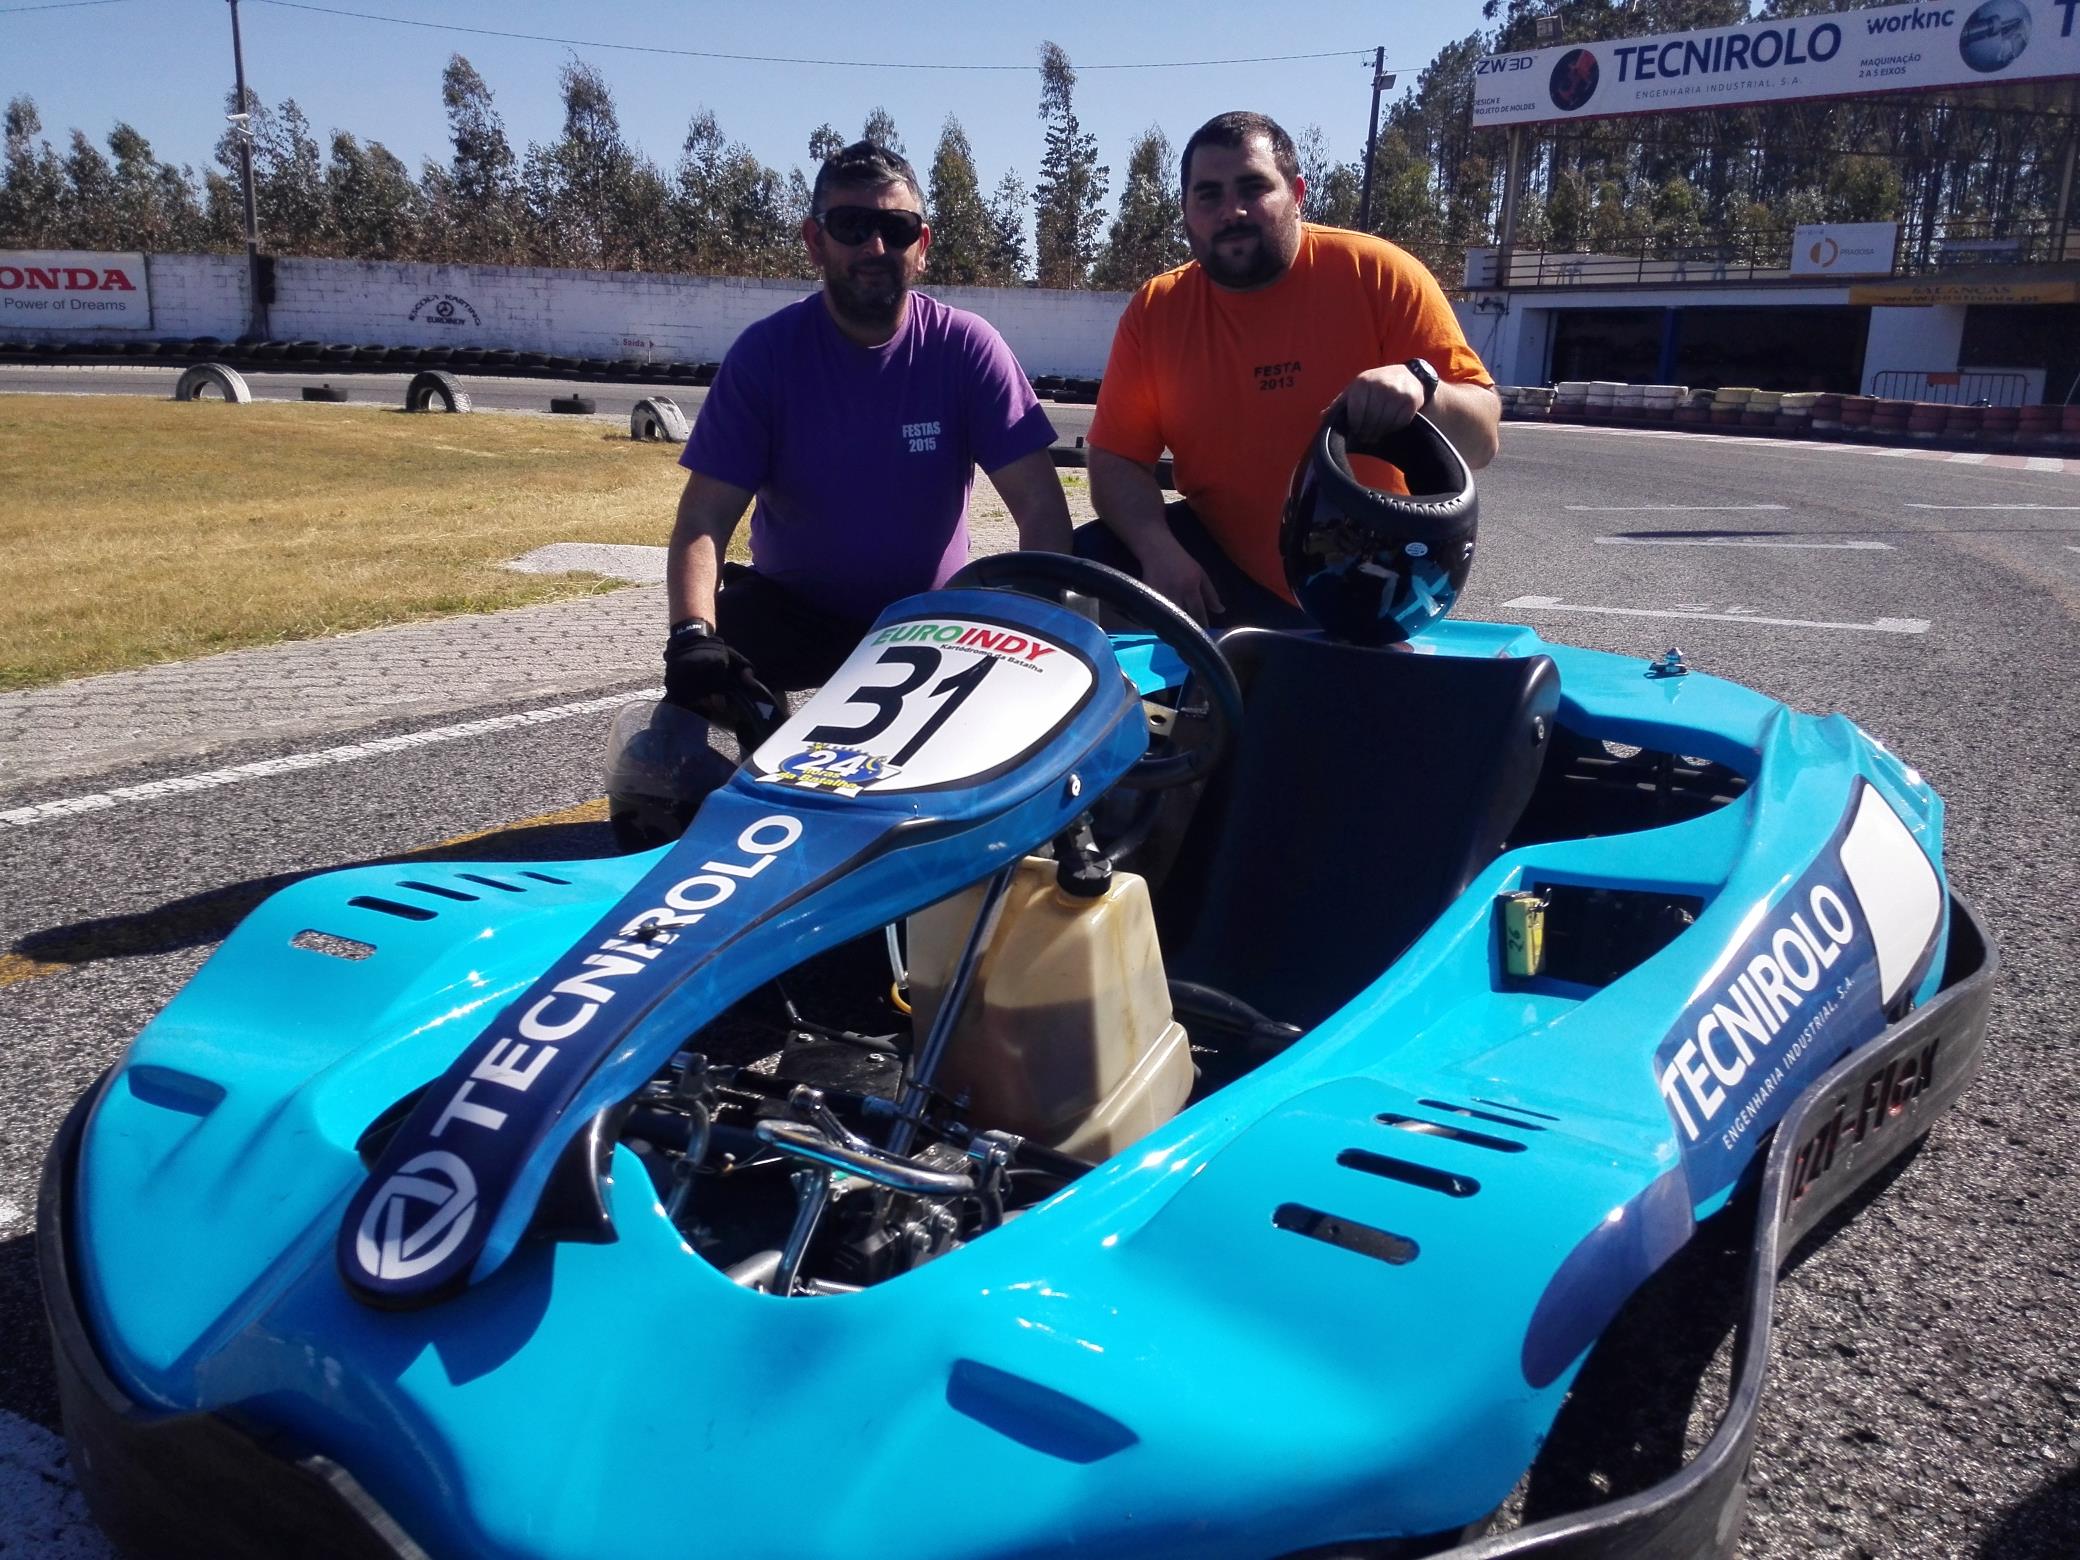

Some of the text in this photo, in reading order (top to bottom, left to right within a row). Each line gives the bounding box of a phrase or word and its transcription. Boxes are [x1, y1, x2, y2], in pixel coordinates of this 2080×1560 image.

[1613, 22, 1842, 82] TECNIROLO
[1880, 66, 1907, 76] EIXOS
[1635, 85, 1701, 100] ENGENHARIA
[1509, 102, 1536, 112] MOLDES
[4, 297, 127, 312] Power of Dreams
[444, 294, 481, 327] KARTING
[1254, 361, 1302, 378] FESTA
[1260, 376, 1295, 391] 2013
[902, 421, 941, 438] FESTAS
[908, 437, 937, 452] 2015
[871, 624, 1056, 661] EUROINDY
[1007, 656, 1044, 674] Batalha
[801, 645, 999, 767] 31
[791, 750, 869, 777] 24
[799, 774, 858, 789] Batalha
[430, 814, 804, 1138] TECNIROLO
[1660, 884, 1854, 1142] TECNIROLO
[1722, 1066, 1785, 1151] ENGENHARIA
